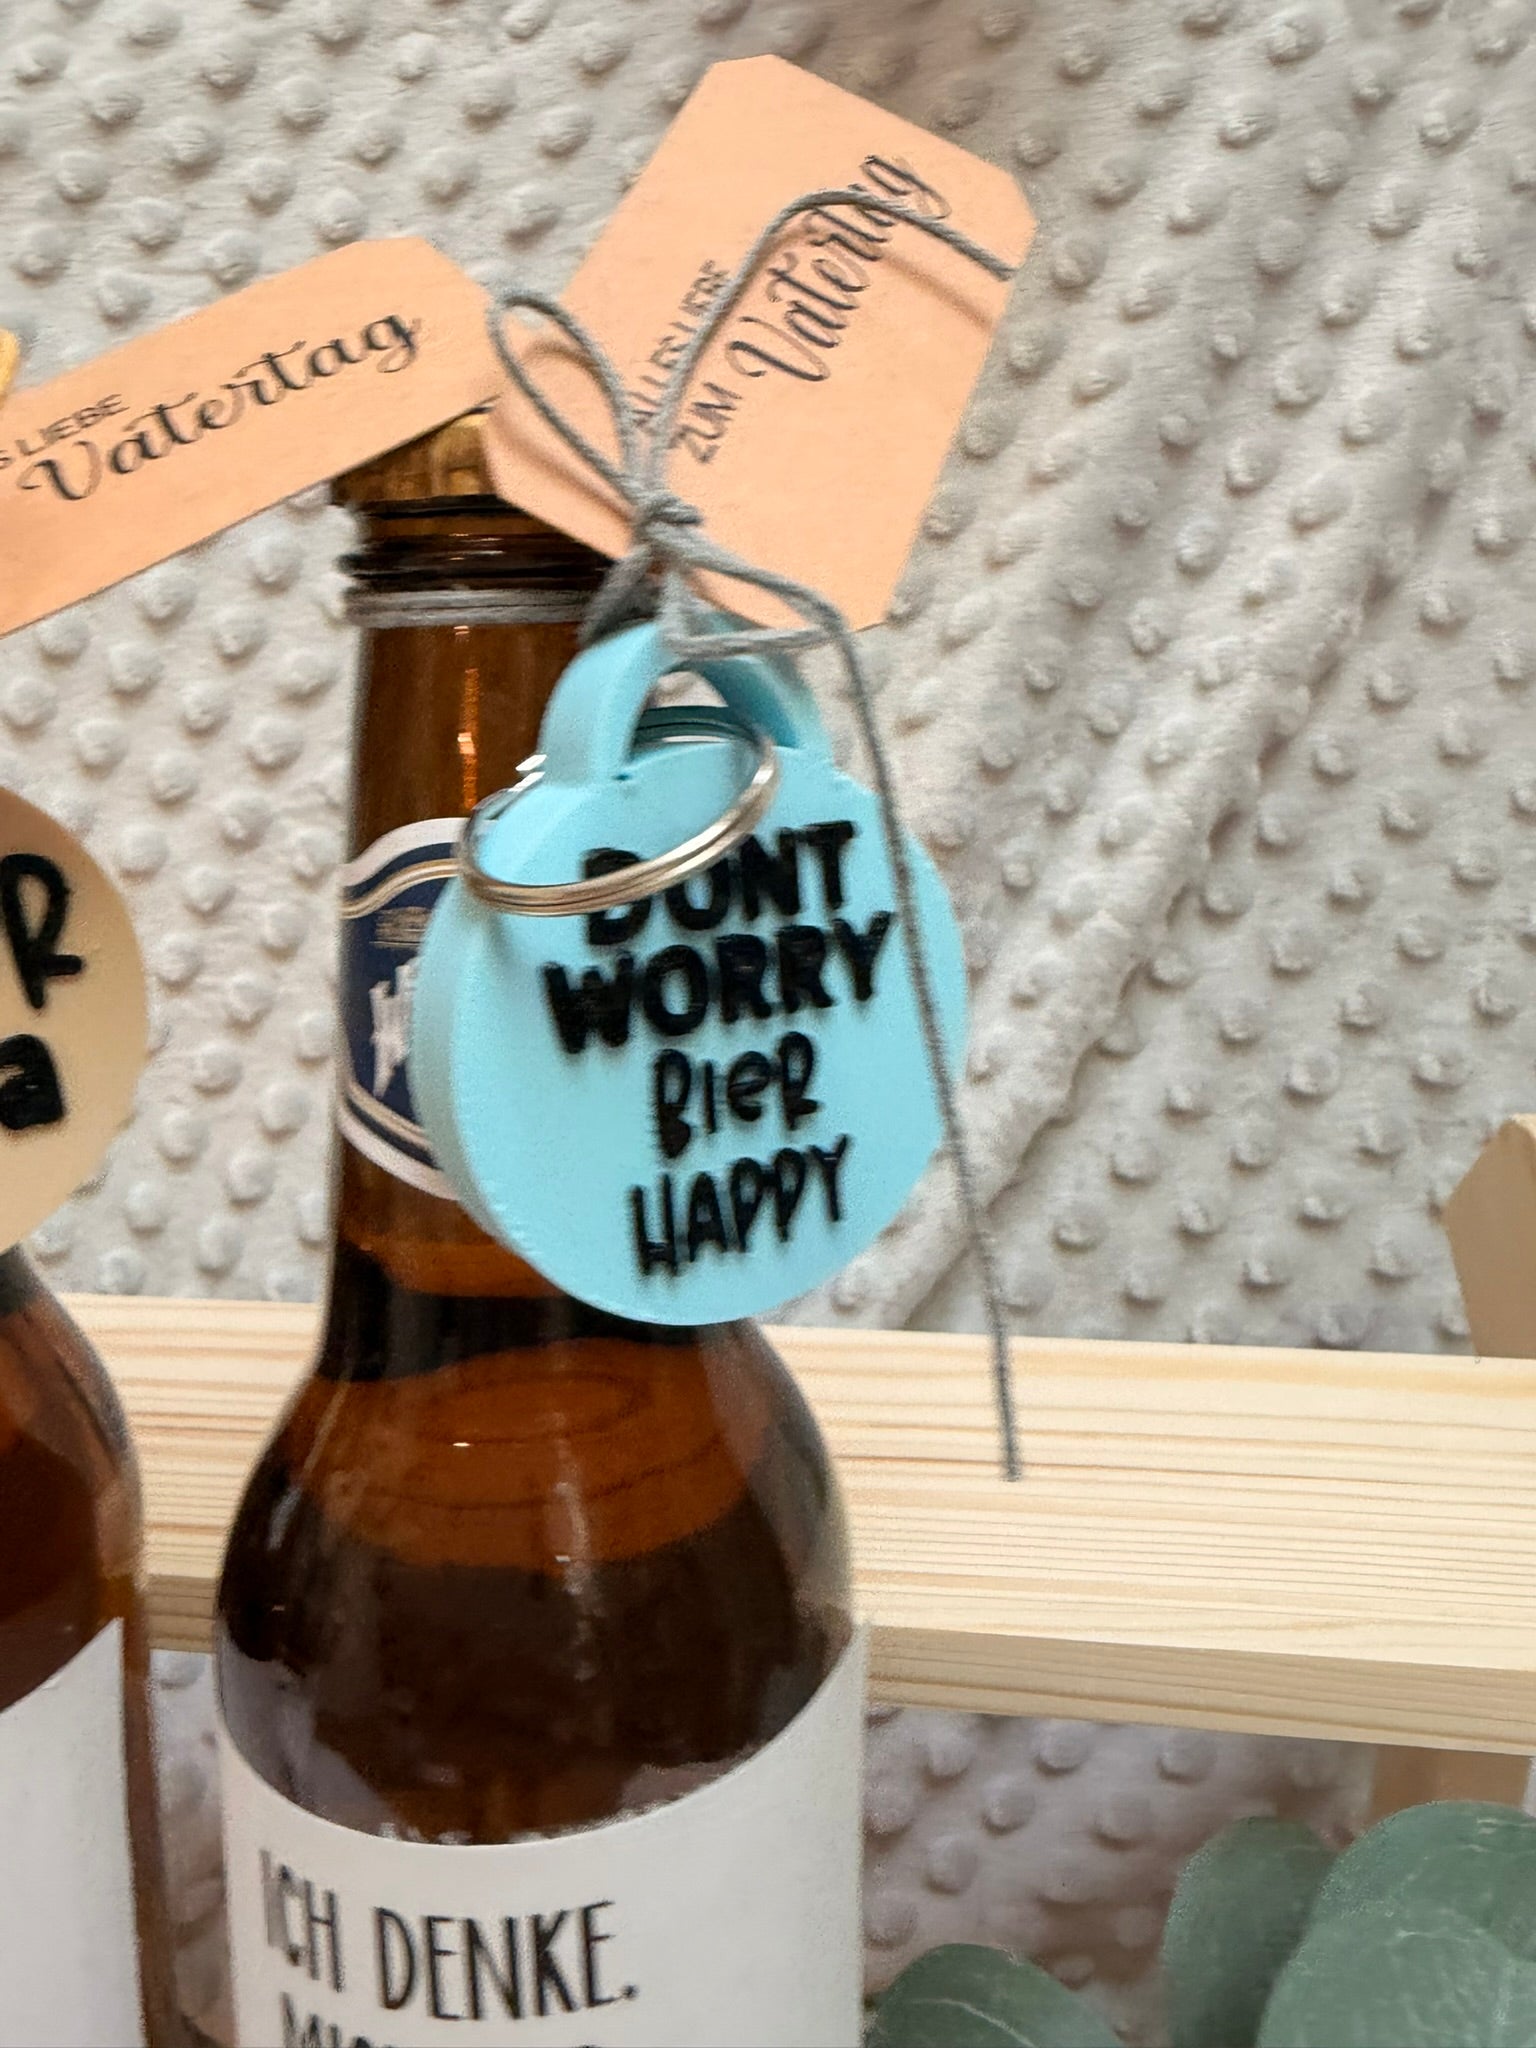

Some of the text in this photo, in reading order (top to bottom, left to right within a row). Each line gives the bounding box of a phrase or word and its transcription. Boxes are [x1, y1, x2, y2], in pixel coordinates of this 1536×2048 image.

[725, 154, 952, 381] Vatertag
[14, 393, 130, 456] LIEBE
[17, 314, 423, 500] Vatertag
[581, 820, 858, 946] DONT
[542, 911, 896, 1056] WORRY
[628, 1134, 852, 1278] HAPPY
[260, 1849, 345, 1992] ICH
[372, 1900, 639, 2021] DENKE.
